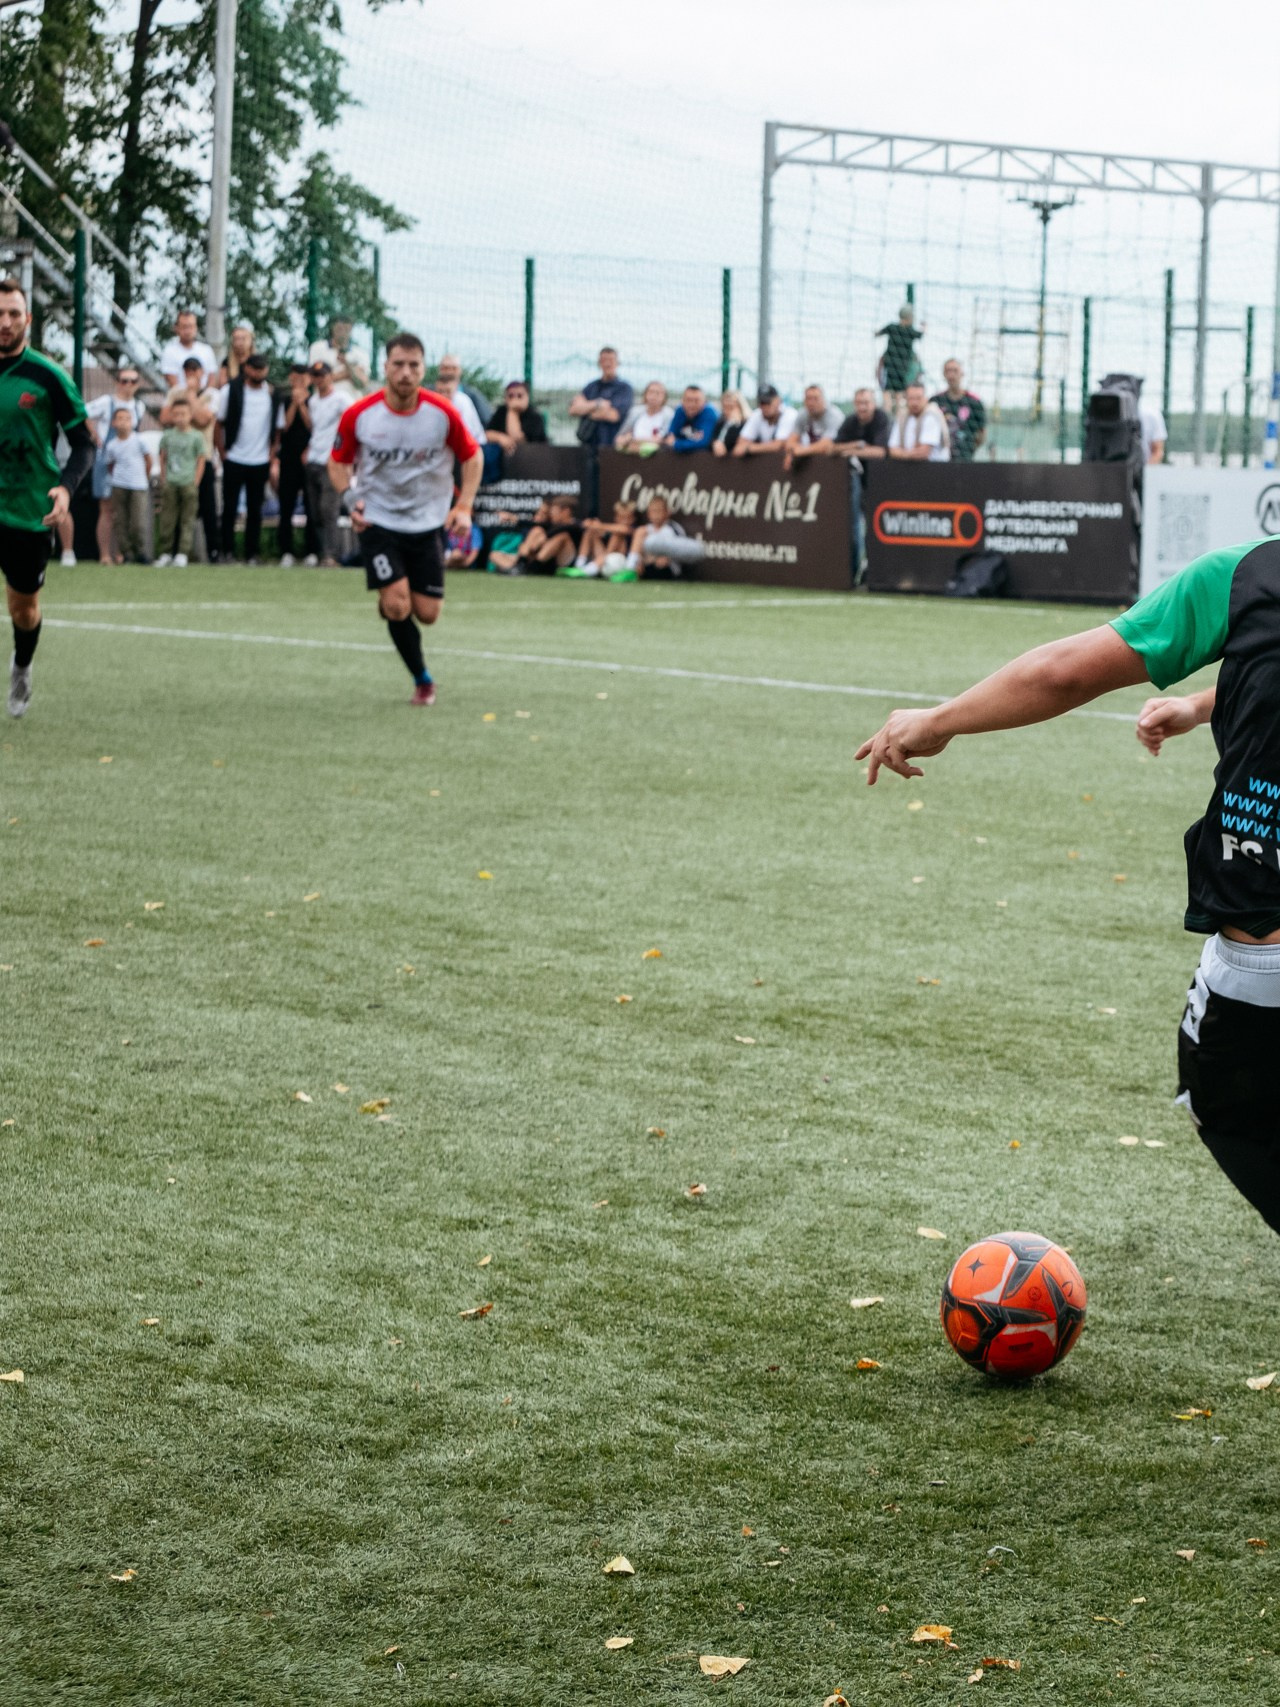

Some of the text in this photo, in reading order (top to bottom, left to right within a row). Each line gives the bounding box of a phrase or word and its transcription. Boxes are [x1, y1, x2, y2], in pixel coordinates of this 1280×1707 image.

[984, 499, 1123, 518] ДАЛЬНЕВОСТОЧНАЯ
[984, 517, 1078, 536] ФУТБОЛЬНАЯ
[984, 535, 1069, 553] МЕДИАЛИГА
[373, 553, 393, 580] 8
